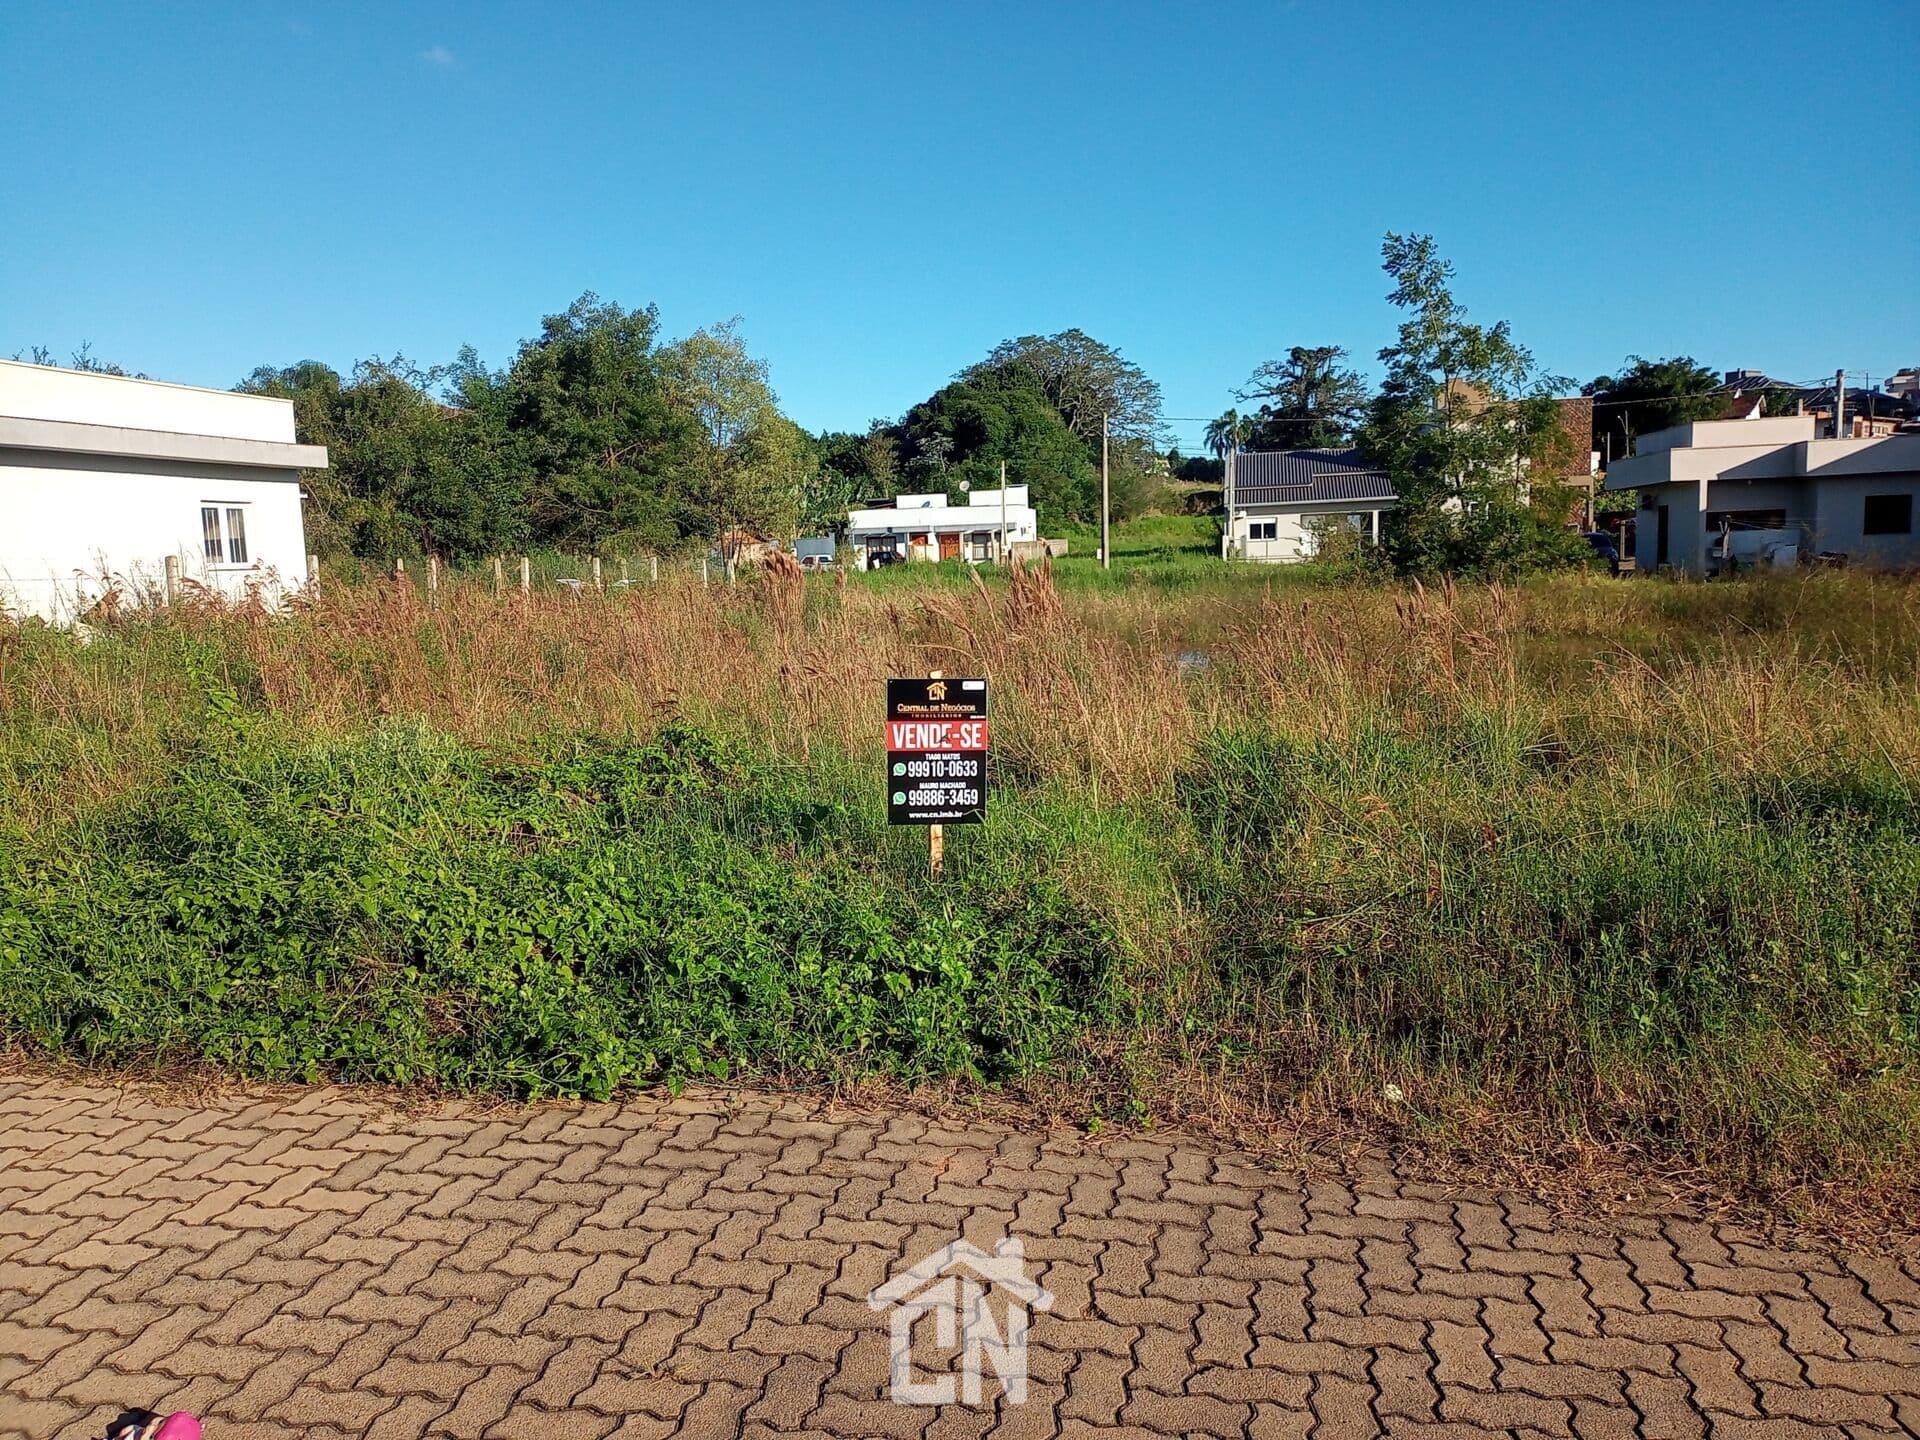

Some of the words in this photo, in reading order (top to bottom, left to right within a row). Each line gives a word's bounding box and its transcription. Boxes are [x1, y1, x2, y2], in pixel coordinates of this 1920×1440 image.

[893, 723, 982, 749] VENDE-SE
[908, 761, 978, 777] 99910-0633
[908, 789, 978, 806] 99886-3459
